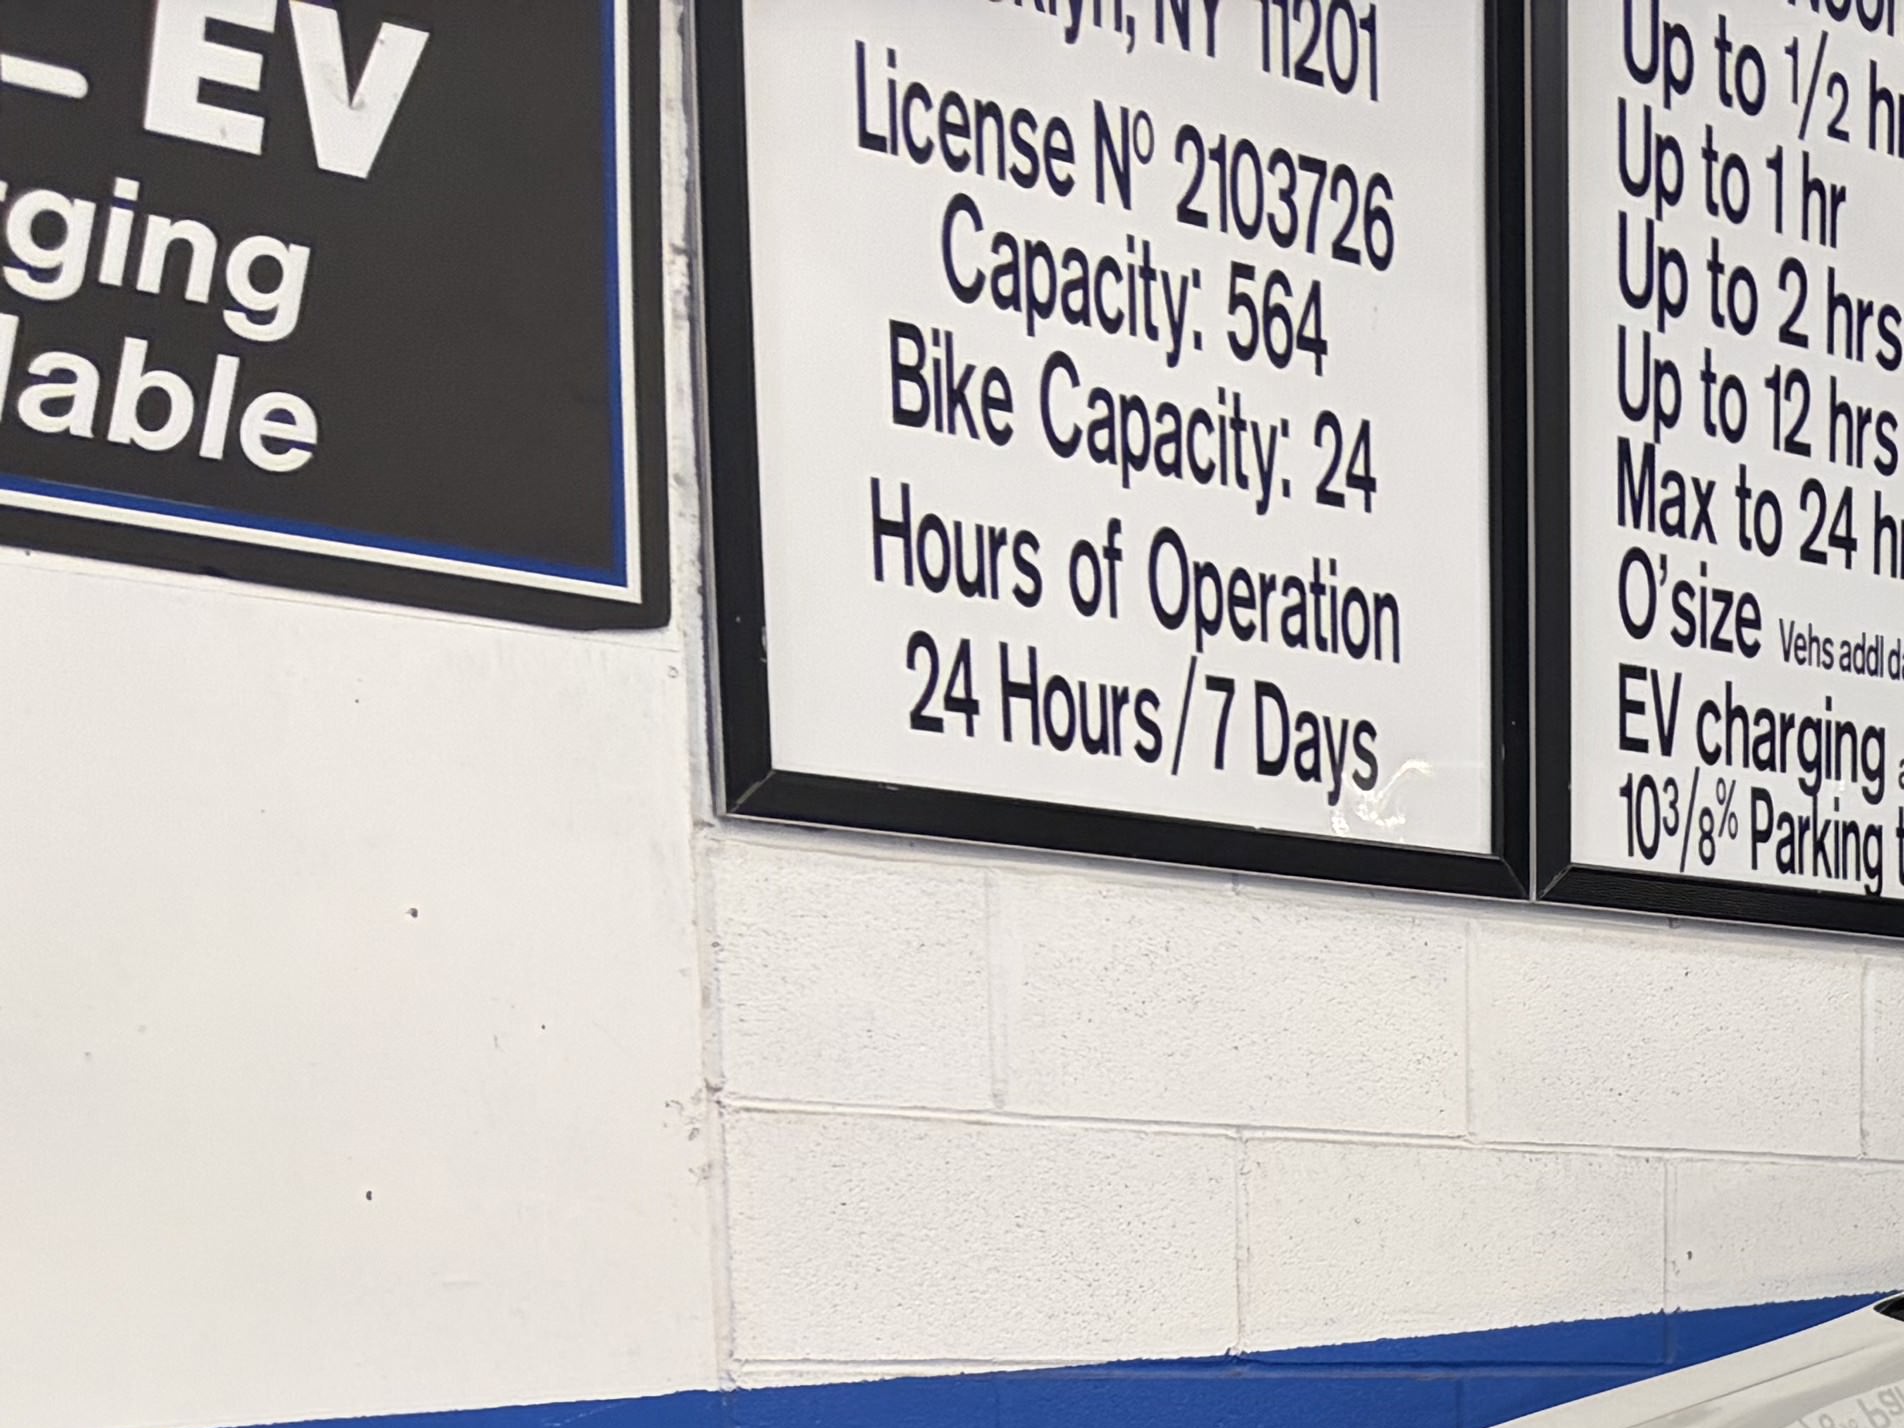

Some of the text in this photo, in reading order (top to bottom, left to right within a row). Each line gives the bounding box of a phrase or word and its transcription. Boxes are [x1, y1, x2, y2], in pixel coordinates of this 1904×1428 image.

[144, 0, 430, 178] EV
[1260, 0, 1377, 101] 11201
[1624, 0, 1694, 110] Up
[1715, 14, 1766, 116] to
[856, 42, 1074, 196] License
[1176, 124, 1394, 270] 2103726
[1618, 98, 1684, 221] Up
[1702, 124, 1750, 224] to
[1766, 146, 1782, 234] 1
[1802, 151, 1846, 248] hr
[0, 178, 310, 342] ging
[942, 194, 1327, 376] Capacity: 564
[1619, 211, 1688, 333] Up
[1708, 238, 1758, 336] to
[1779, 258, 1808, 348] 2
[1828, 267, 1902, 371] hrs
[890, 320, 1376, 515] Bike Capacity: 24
[1618, 325, 1682, 444] Up
[1701, 348, 1746, 443] to
[1765, 365, 1810, 457] 12
[1830, 376, 1898, 476] hrs
[872, 478, 1400, 663] Hours of Operation
[1618, 437, 1716, 544] Max
[1736, 464, 1782, 556] to
[1800, 478, 1857, 569] 24
[907, 631, 979, 736] 24
[1255, 680, 1378, 806] Days
[1780, 619, 1834, 670] Vehs
[1840, 632, 1883, 677] addl
[1620, 664, 1682, 756] EV
[1695, 681, 1886, 804] charging
[1751, 788, 1883, 898] Parking
